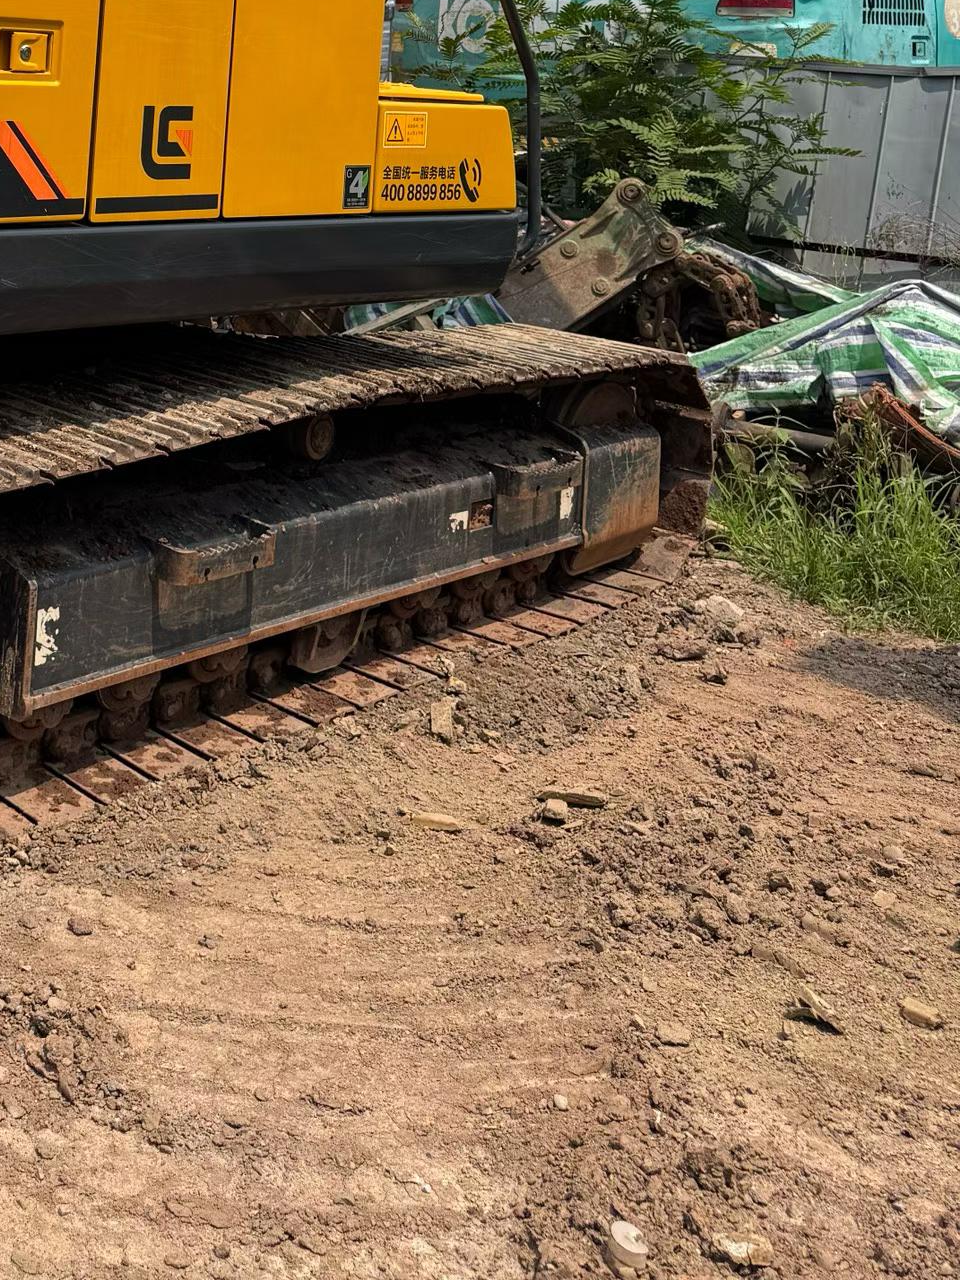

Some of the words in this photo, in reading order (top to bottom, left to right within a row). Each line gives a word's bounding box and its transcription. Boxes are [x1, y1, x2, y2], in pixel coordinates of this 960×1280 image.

[382, 165, 456, 180] 全国统一服务电话
[381, 183, 405, 201] 400
[407, 183, 437, 201] 8899
[439, 183, 461, 200] 856
